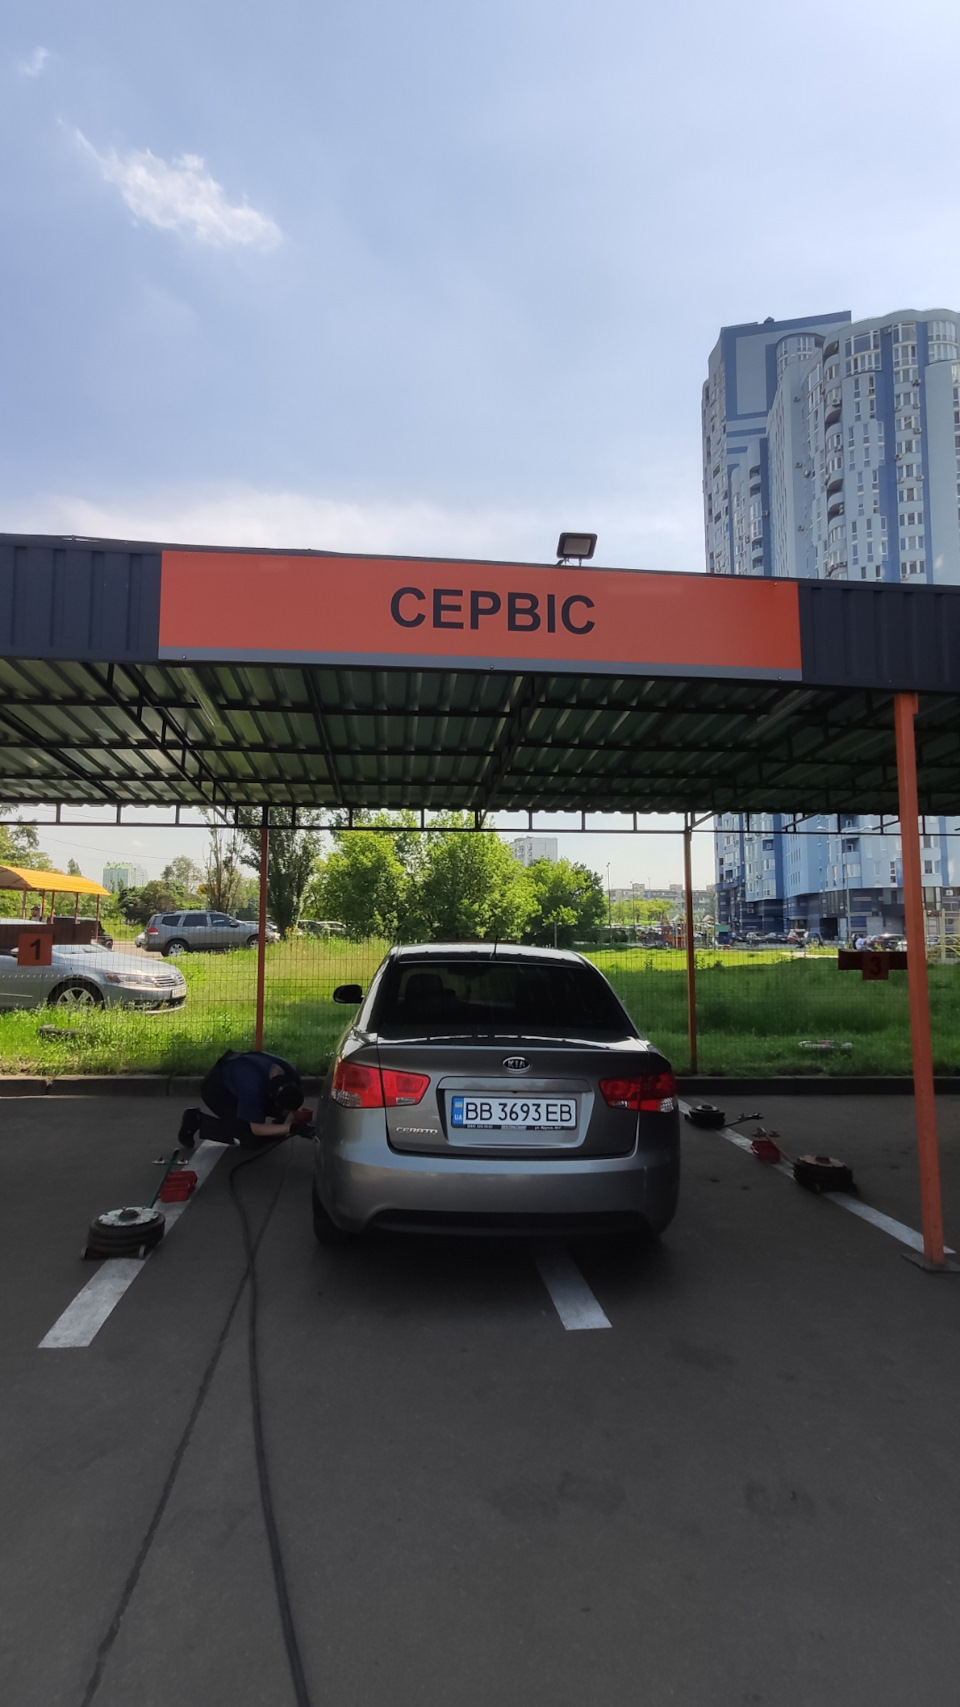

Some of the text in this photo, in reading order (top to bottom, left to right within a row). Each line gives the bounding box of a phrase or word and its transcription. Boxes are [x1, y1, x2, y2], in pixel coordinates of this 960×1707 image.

[390, 586, 596, 635] СЕРВІС
[30, 938, 41, 961] 1
[870, 956, 881, 975] 3
[507, 1060, 526, 1069] KIA
[465, 1102, 573, 1123] BB 3693 EB
